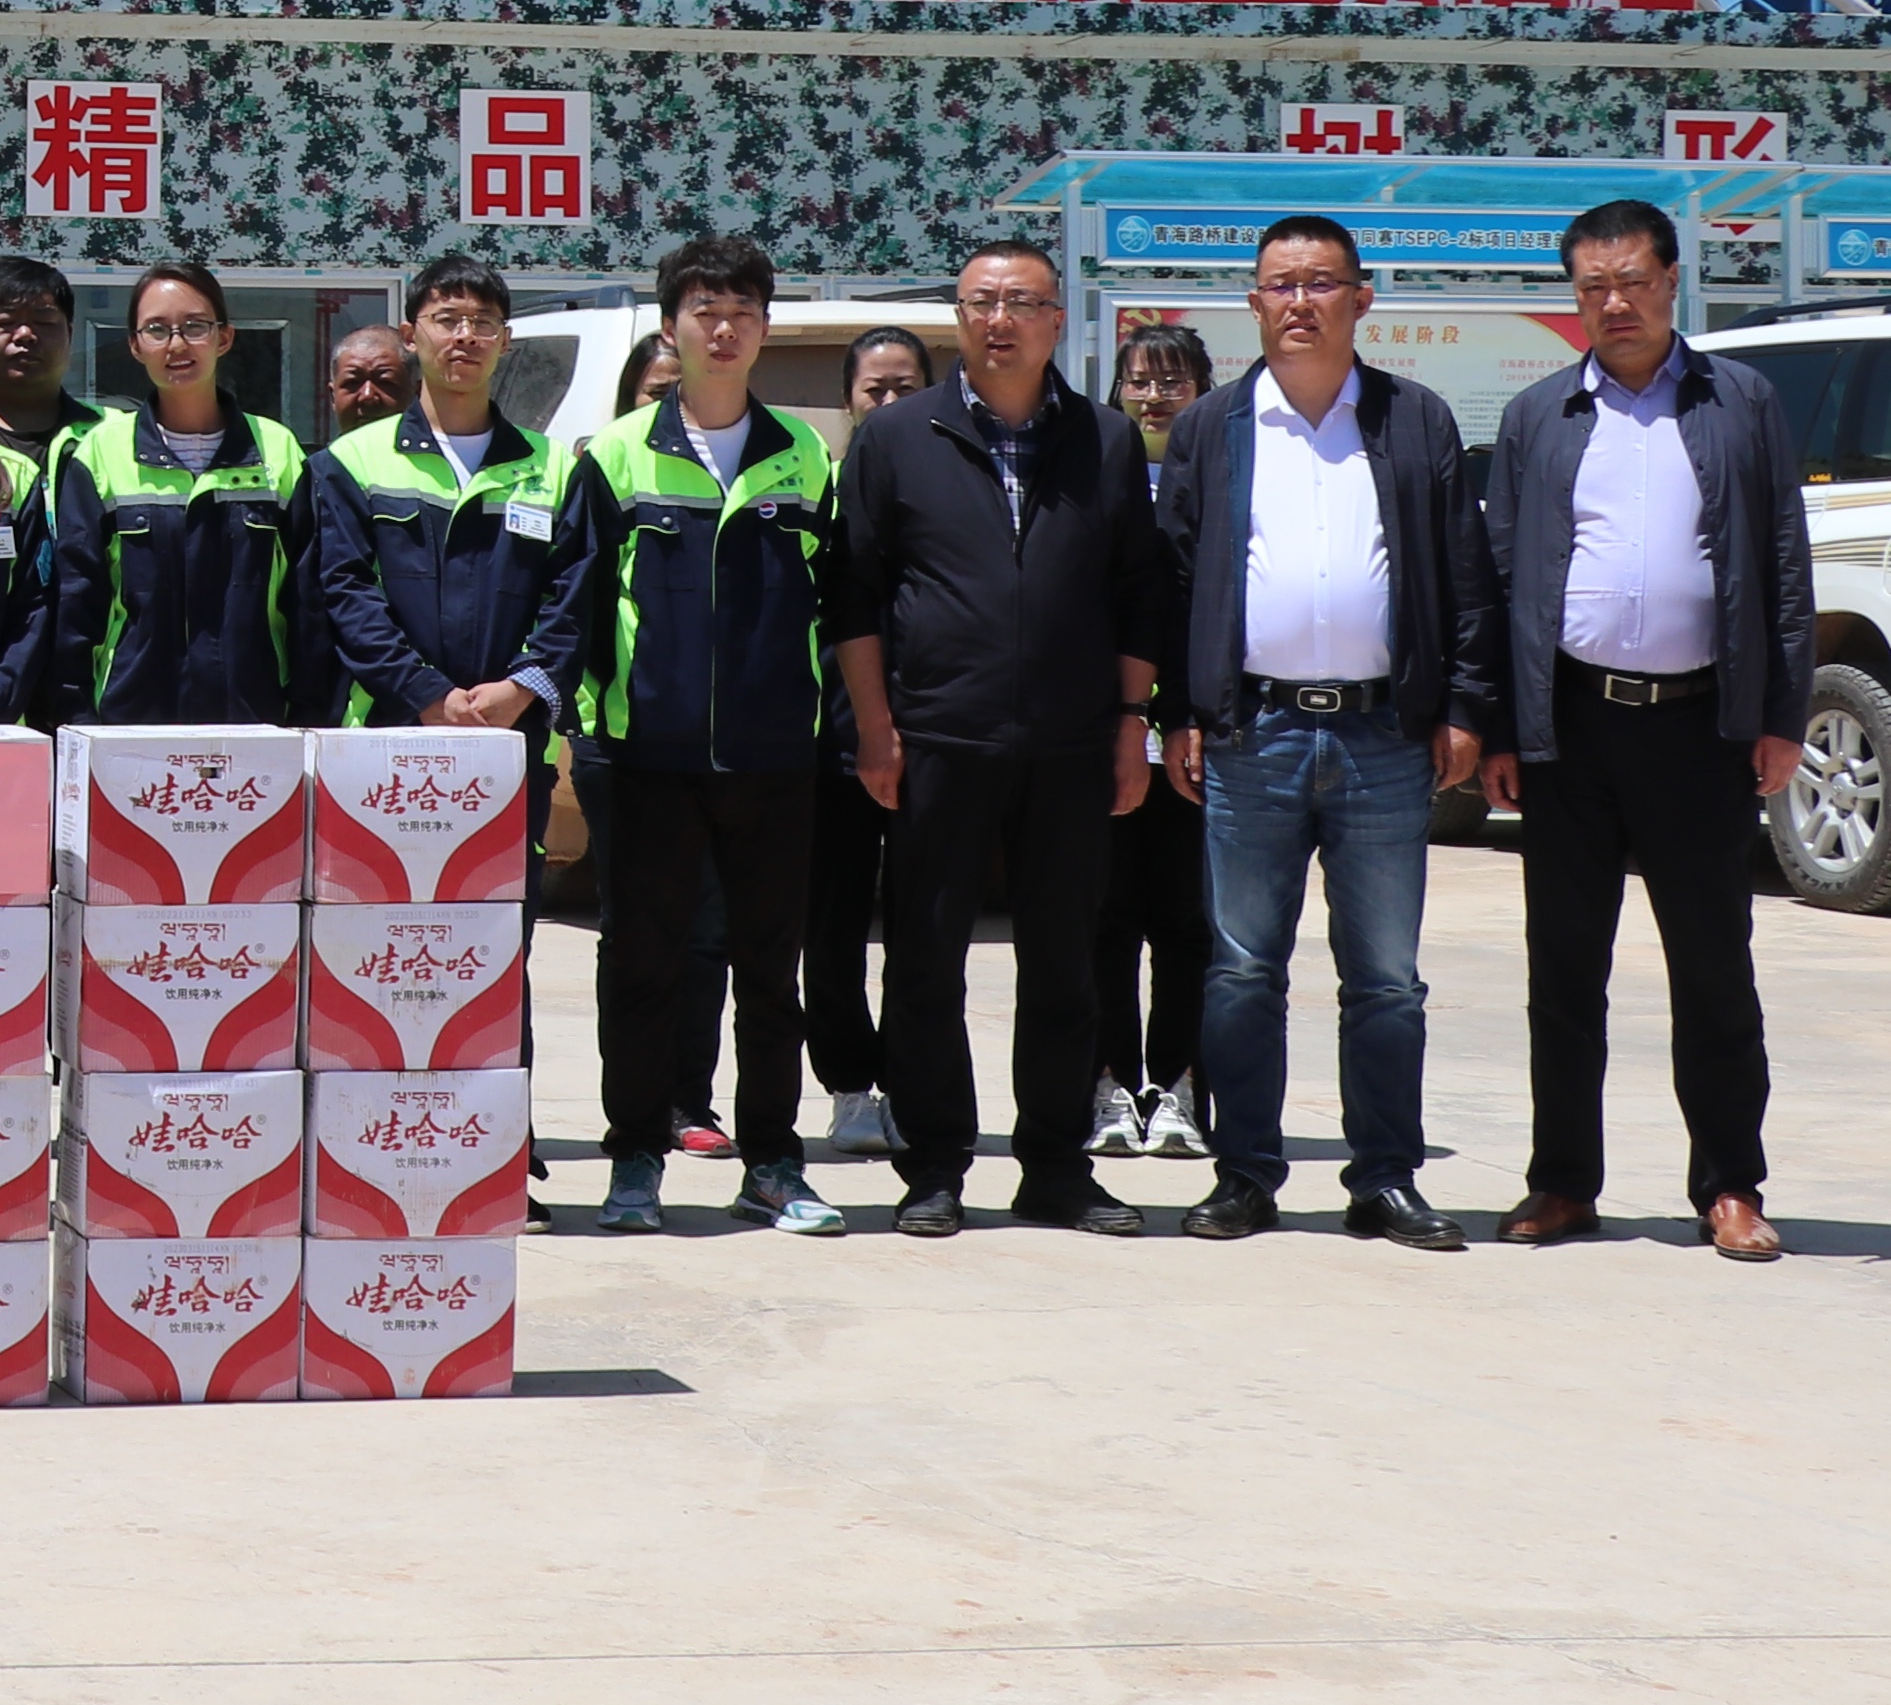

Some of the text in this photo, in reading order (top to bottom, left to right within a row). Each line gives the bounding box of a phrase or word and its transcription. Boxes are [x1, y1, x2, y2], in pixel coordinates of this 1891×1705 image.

[32, 86, 157, 212] 精
[472, 97, 580, 217] 品
[1153, 225, 1266, 245] 青海路桥建设
[1353, 323, 1461, 345] 发展阶段
[143, 774, 263, 813] 娃哈哈
[362, 775, 487, 813] 娃哈哈
[127, 943, 258, 981] 娃哈哈
[356, 944, 479, 983] 娃哈哈
[130, 1113, 258, 1151] 娃哈哈
[360, 1112, 486, 1150] 娃哈哈
[133, 1276, 258, 1315] 娃哈哈
[347, 1274, 473, 1312] 娃哈哈
